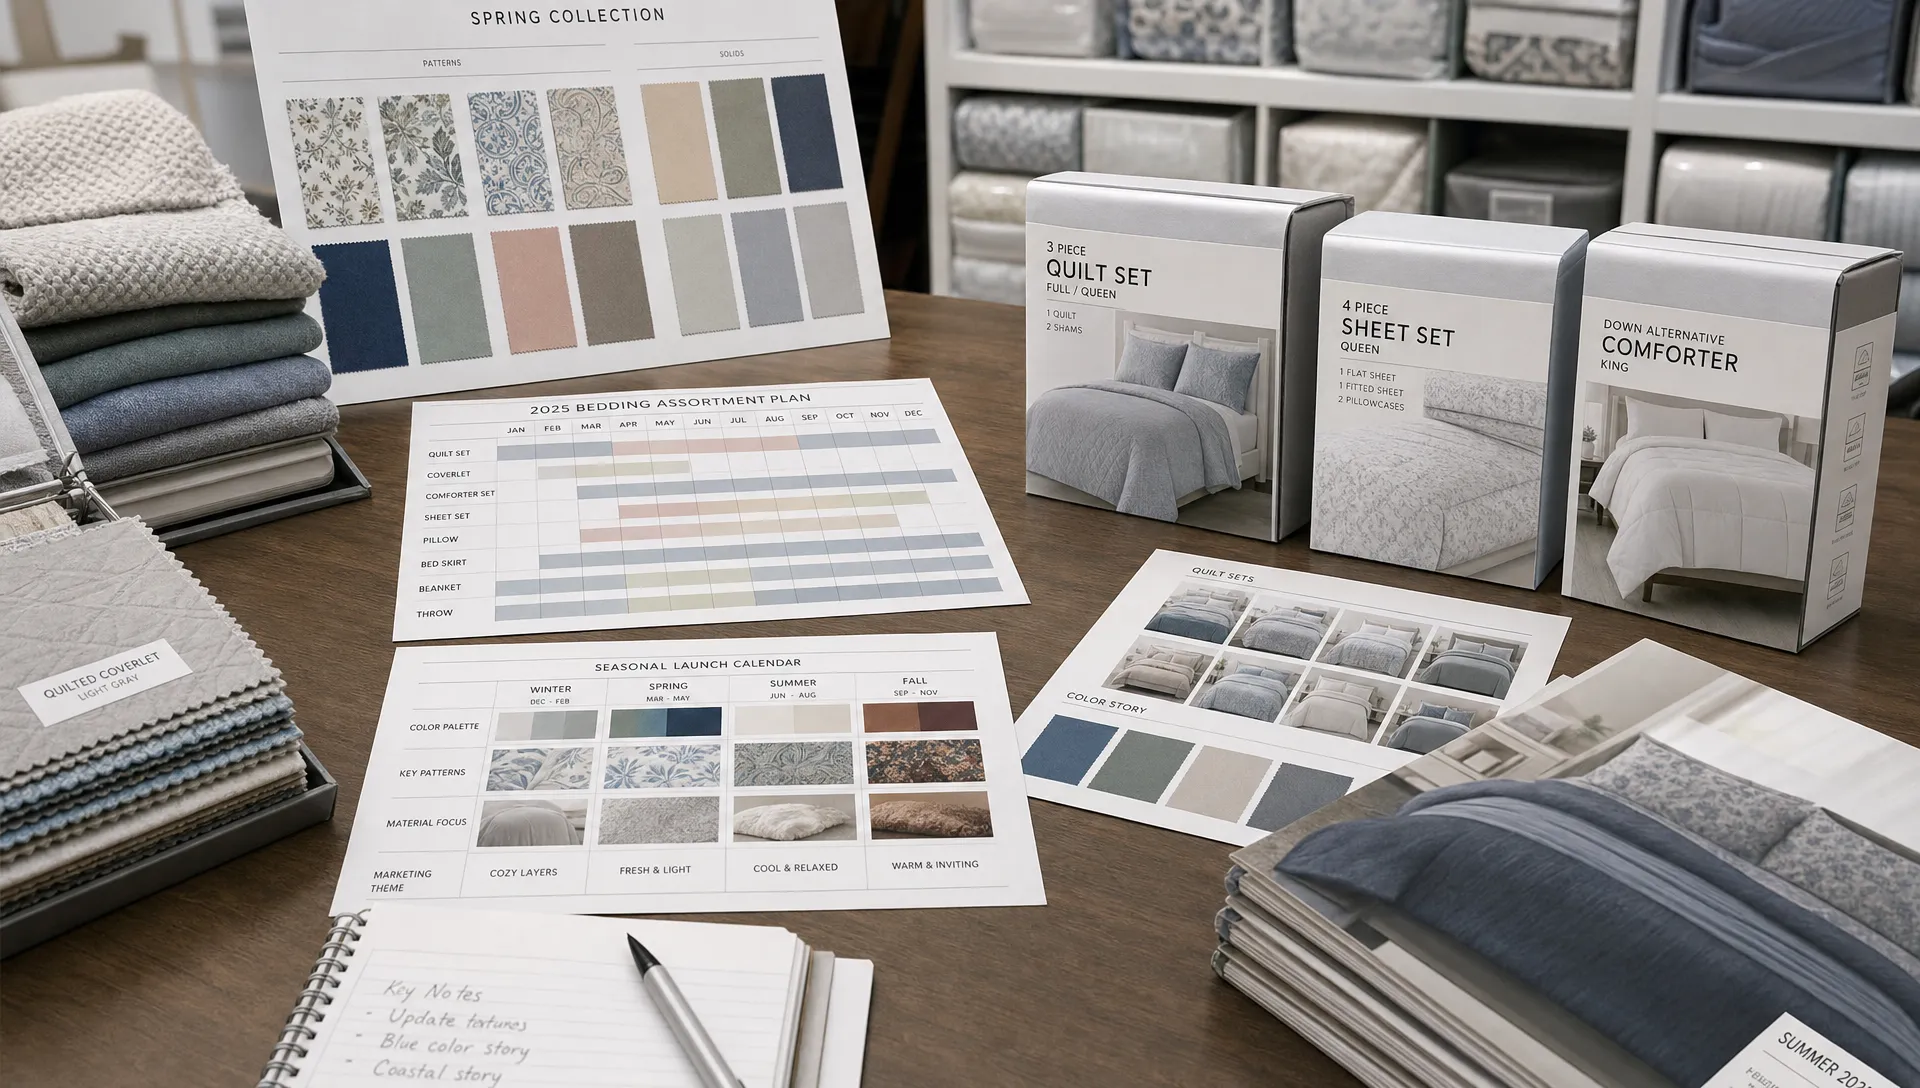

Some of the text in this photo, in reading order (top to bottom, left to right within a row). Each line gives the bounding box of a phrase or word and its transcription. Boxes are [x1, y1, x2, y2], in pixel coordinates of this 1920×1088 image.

[470, 7, 665, 26] SPRING COLLECTION
[719, 49, 745, 58] SOLIDS
[422, 58, 462, 68] PATTERNS
[1047, 241, 1086, 256] 3 PIECE
[1047, 259, 1152, 286] QUILT SET
[1047, 283, 1116, 299] FULL / QUEEN
[1053, 310, 1076, 319] QUILT
[1342, 300, 1388, 315] 4 PIECE
[1054, 324, 1083, 334] SHAMS
[1342, 318, 1455, 347] SHEET SET
[1604, 319, 1725, 345] DOWN ALTERNATIVE
[1340, 342, 1379, 354] QUEEN
[1602, 336, 1738, 372] COMFORTER
[1601, 360, 1628, 372] KING
[1347, 369, 1367, 378] FLAT
[1370, 372, 1396, 382] SHEET
[1346, 383, 1374, 393] FITTED
[1378, 387, 1404, 397] SHEET
[530, 393, 812, 415] 2025 BEDDING ASSORTMENT PLAN
[1346, 397, 1405, 411] PILLOWCASES
[581, 422, 602, 430] MAR
[619, 420, 638, 428] APR
[801, 413, 819, 421] SEP
[836, 412, 855, 420] OCT
[904, 409, 924, 417] DEC
[426, 491, 478, 499] COMFORTER
[1192, 567, 1254, 582] QUILT SETS
[595, 659, 800, 672] SEASONAL LAUNCH CALENDAR
[43, 652, 160, 699] QUILTED COVERLET
[77, 674, 139, 701] LIGHT GRAY
[1067, 692, 1147, 713] COLOR STORY
[386, 820, 433, 828] MATERIAL
[794, 864, 838, 872] RELAXED
[936, 860, 979, 868] INVITING
[374, 870, 432, 878] MARKETING
[520, 868, 558, 876] LAYERS
[383, 980, 482, 1003] Key Notes
[389, 1008, 455, 1028] Update
[380, 1033, 419, 1051] Blue
[428, 1038, 475, 1054] color
[484, 1041, 530, 1065] story
[1778, 1032, 1872, 1088] SUMMER 202
[373, 1059, 448, 1080] Coastal
[454, 1066, 502, 1088] story
